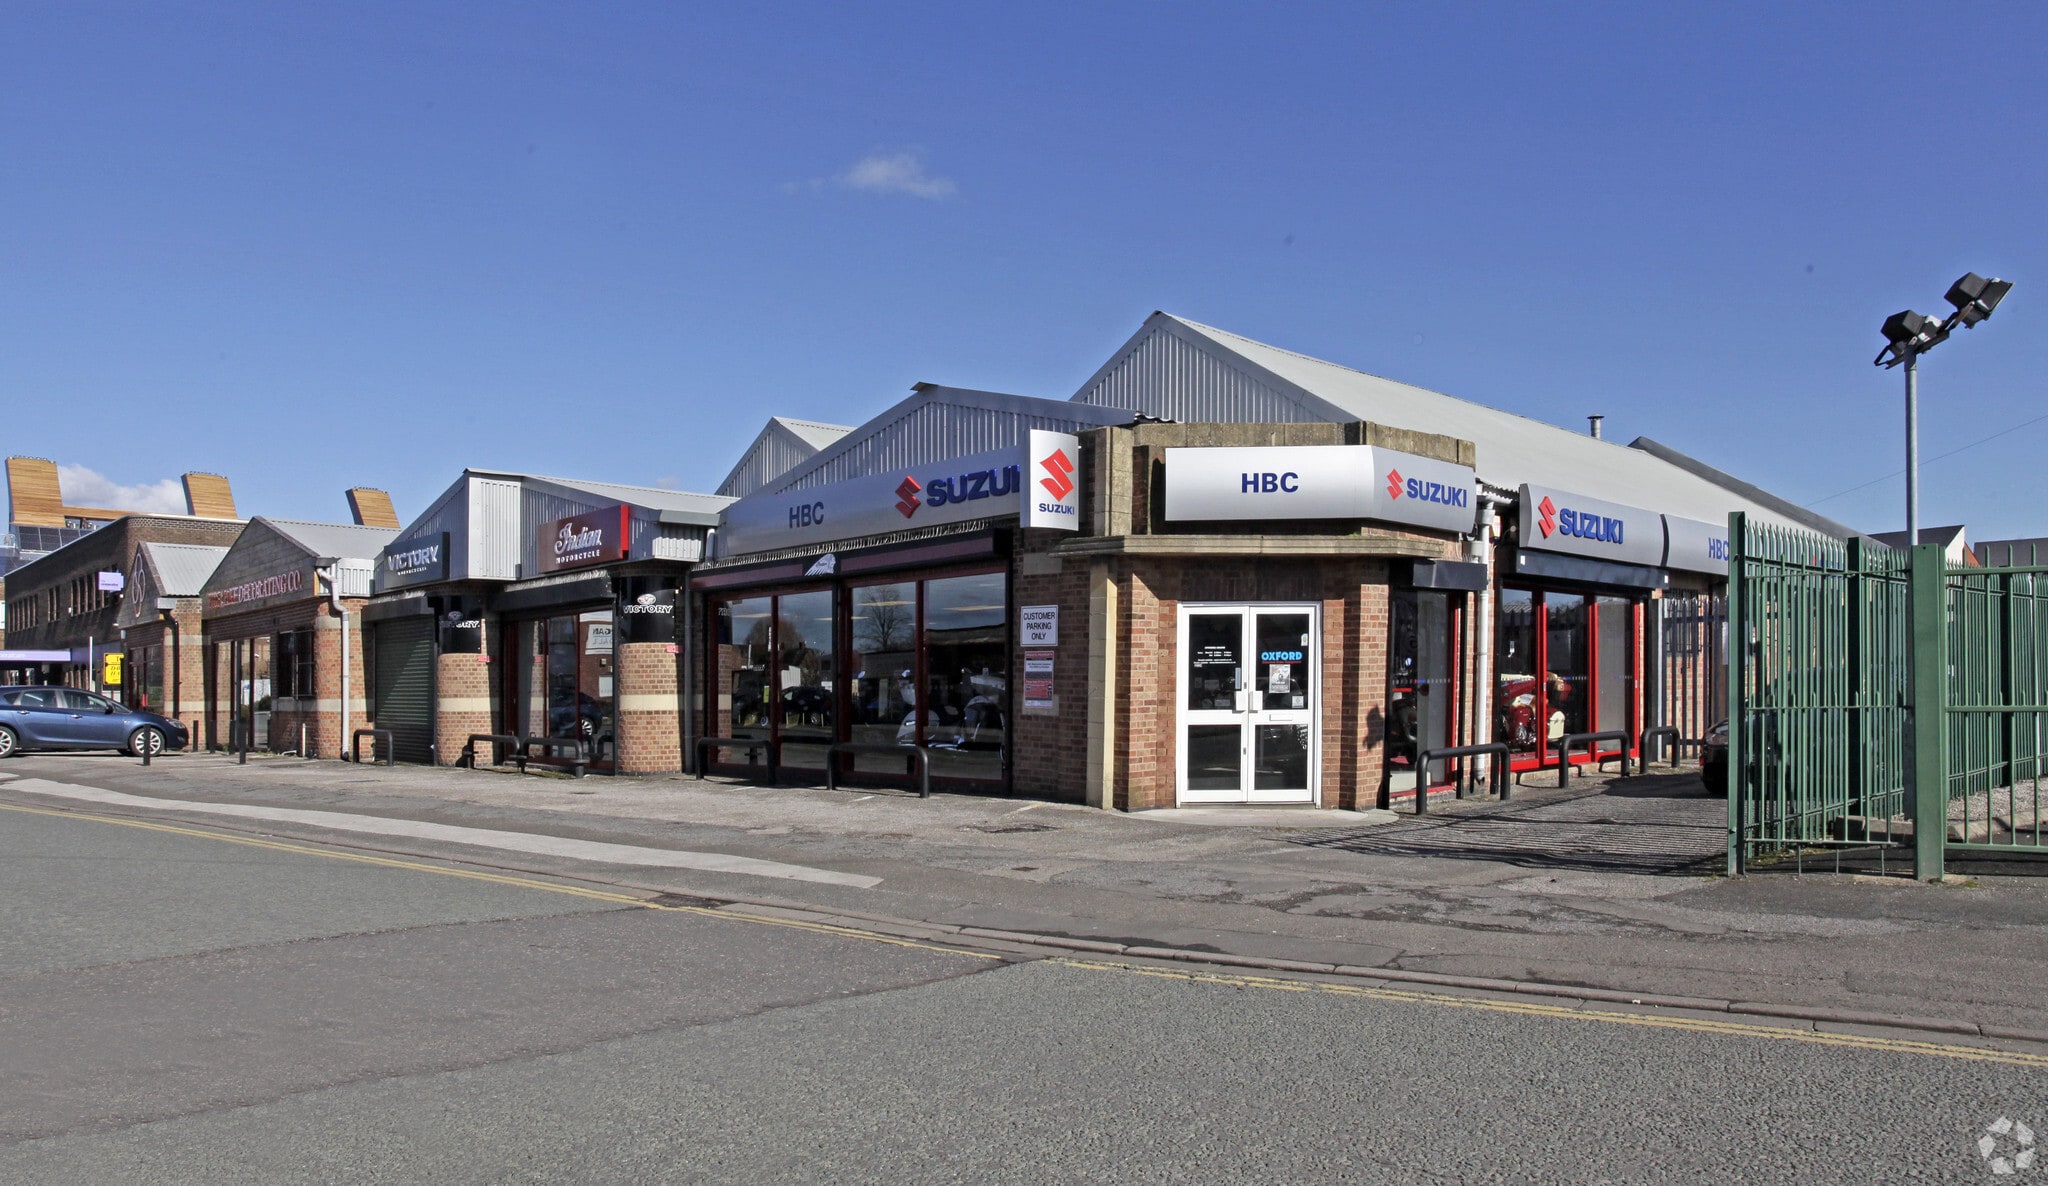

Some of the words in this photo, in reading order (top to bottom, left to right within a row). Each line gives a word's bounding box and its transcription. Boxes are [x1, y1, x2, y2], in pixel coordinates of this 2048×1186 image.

[1241, 472, 1299, 493] HBC
[789, 501, 825, 529] HBC
[926, 464, 1021, 507] SUZU
[1407, 478, 1467, 508] SUZUKI
[1039, 503, 1075, 516] SUZUKI
[1559, 508, 1624, 545] SUZUKI
[554, 522, 602, 555] Indian
[388, 545, 439, 571] VICTORY
[556, 549, 600, 565] MOTORCYCLE
[622, 604, 674, 614] VICTORY
[1023, 611, 1056, 621] CUSTOMER
[1026, 621, 1052, 631] PARKING
[1031, 631, 1047, 641] ONLY
[1261, 651, 1303, 661] OXFORD
